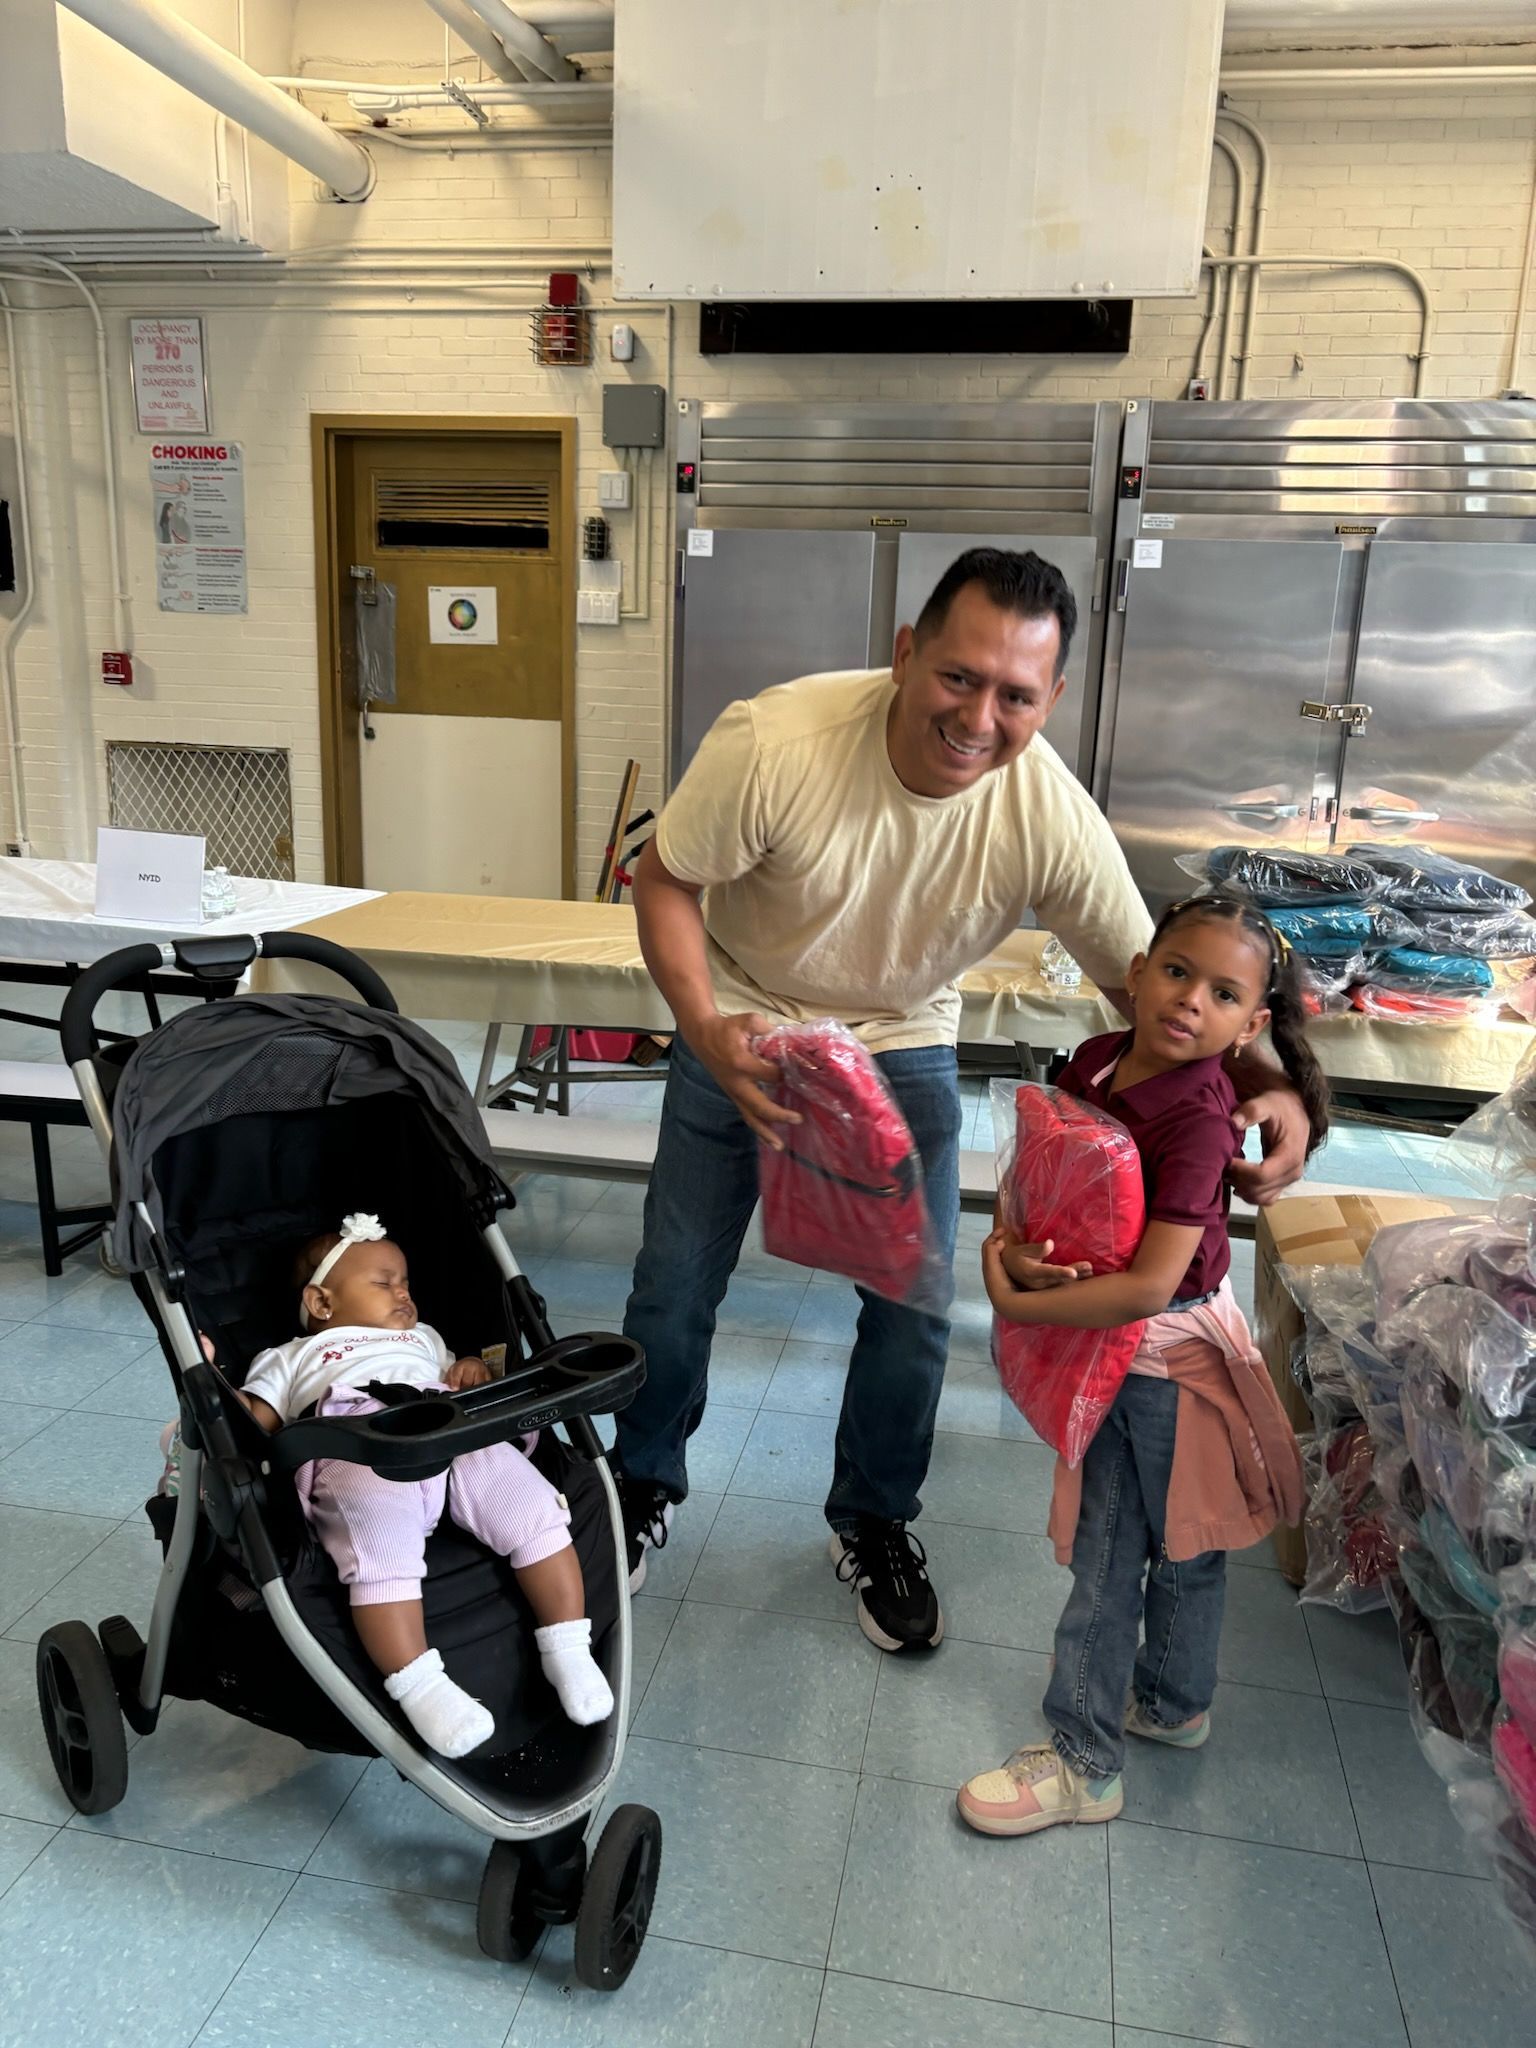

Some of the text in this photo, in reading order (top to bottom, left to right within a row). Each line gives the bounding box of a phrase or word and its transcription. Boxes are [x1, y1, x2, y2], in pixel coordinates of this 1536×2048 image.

[134, 336, 199, 345] BY MORE THAN
[155, 344, 181, 360] 270
[142, 364, 194, 374] PERSONS IS
[142, 378, 196, 388] DANGEROUS
[161, 390, 180, 398] AND
[148, 401, 193, 410] UNLAWFUL
[152, 446, 228, 460] CHOKING
[138, 873, 161, 883] NYID
